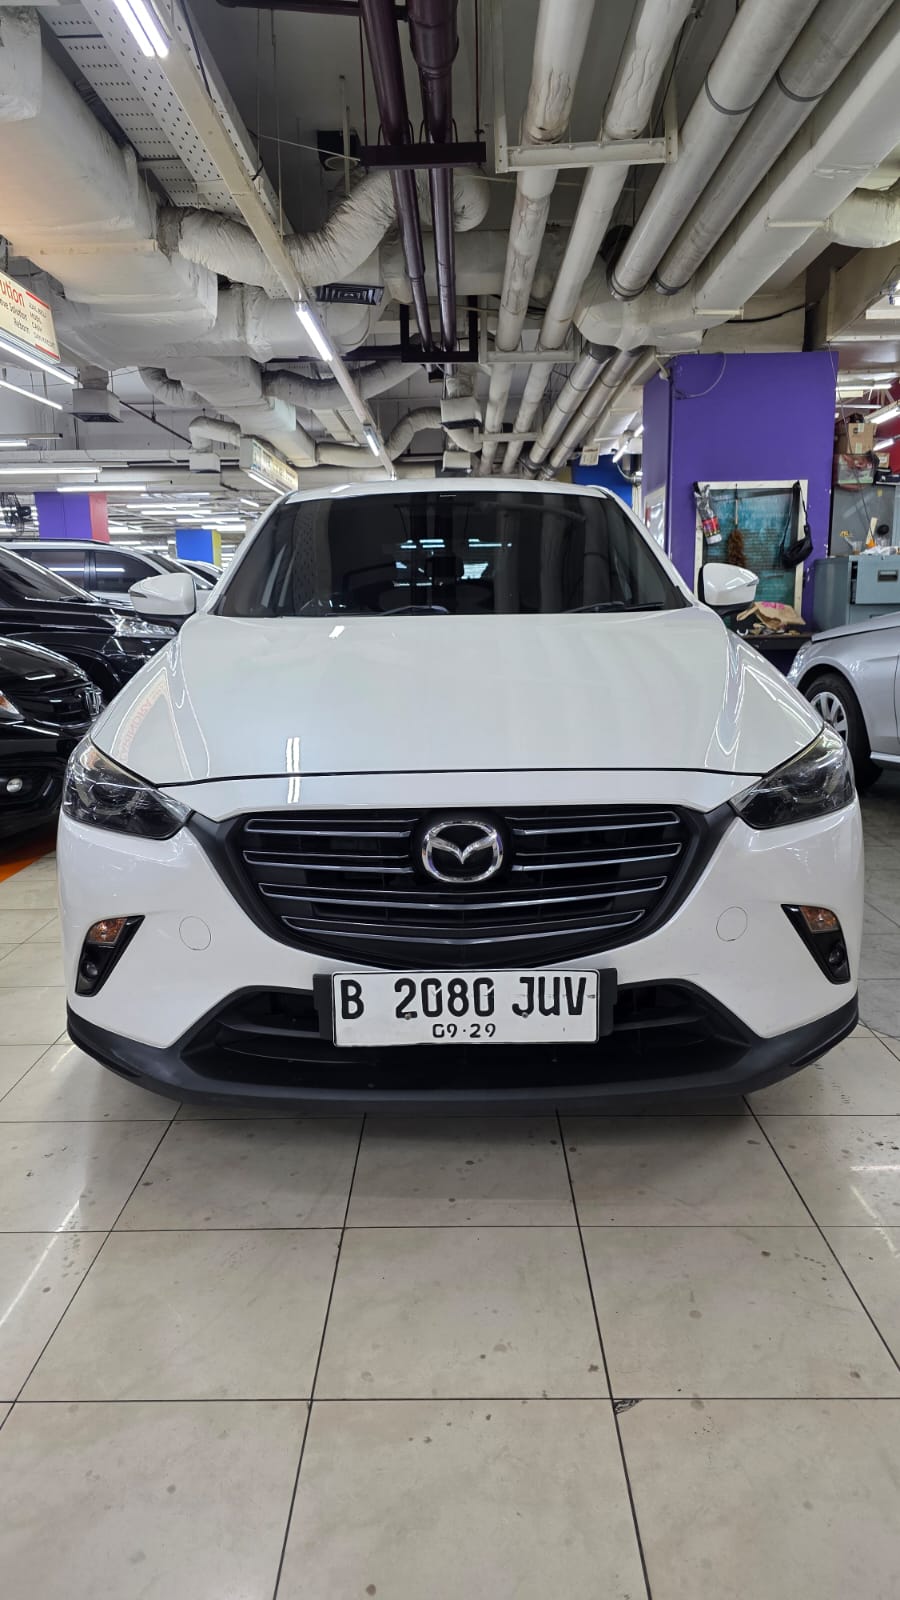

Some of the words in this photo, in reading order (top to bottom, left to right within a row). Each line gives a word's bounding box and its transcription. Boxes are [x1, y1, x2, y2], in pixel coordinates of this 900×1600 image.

[340, 979, 365, 1020] B
[394, 977, 495, 1020] 2080
[512, 976, 587, 1018] JUV
